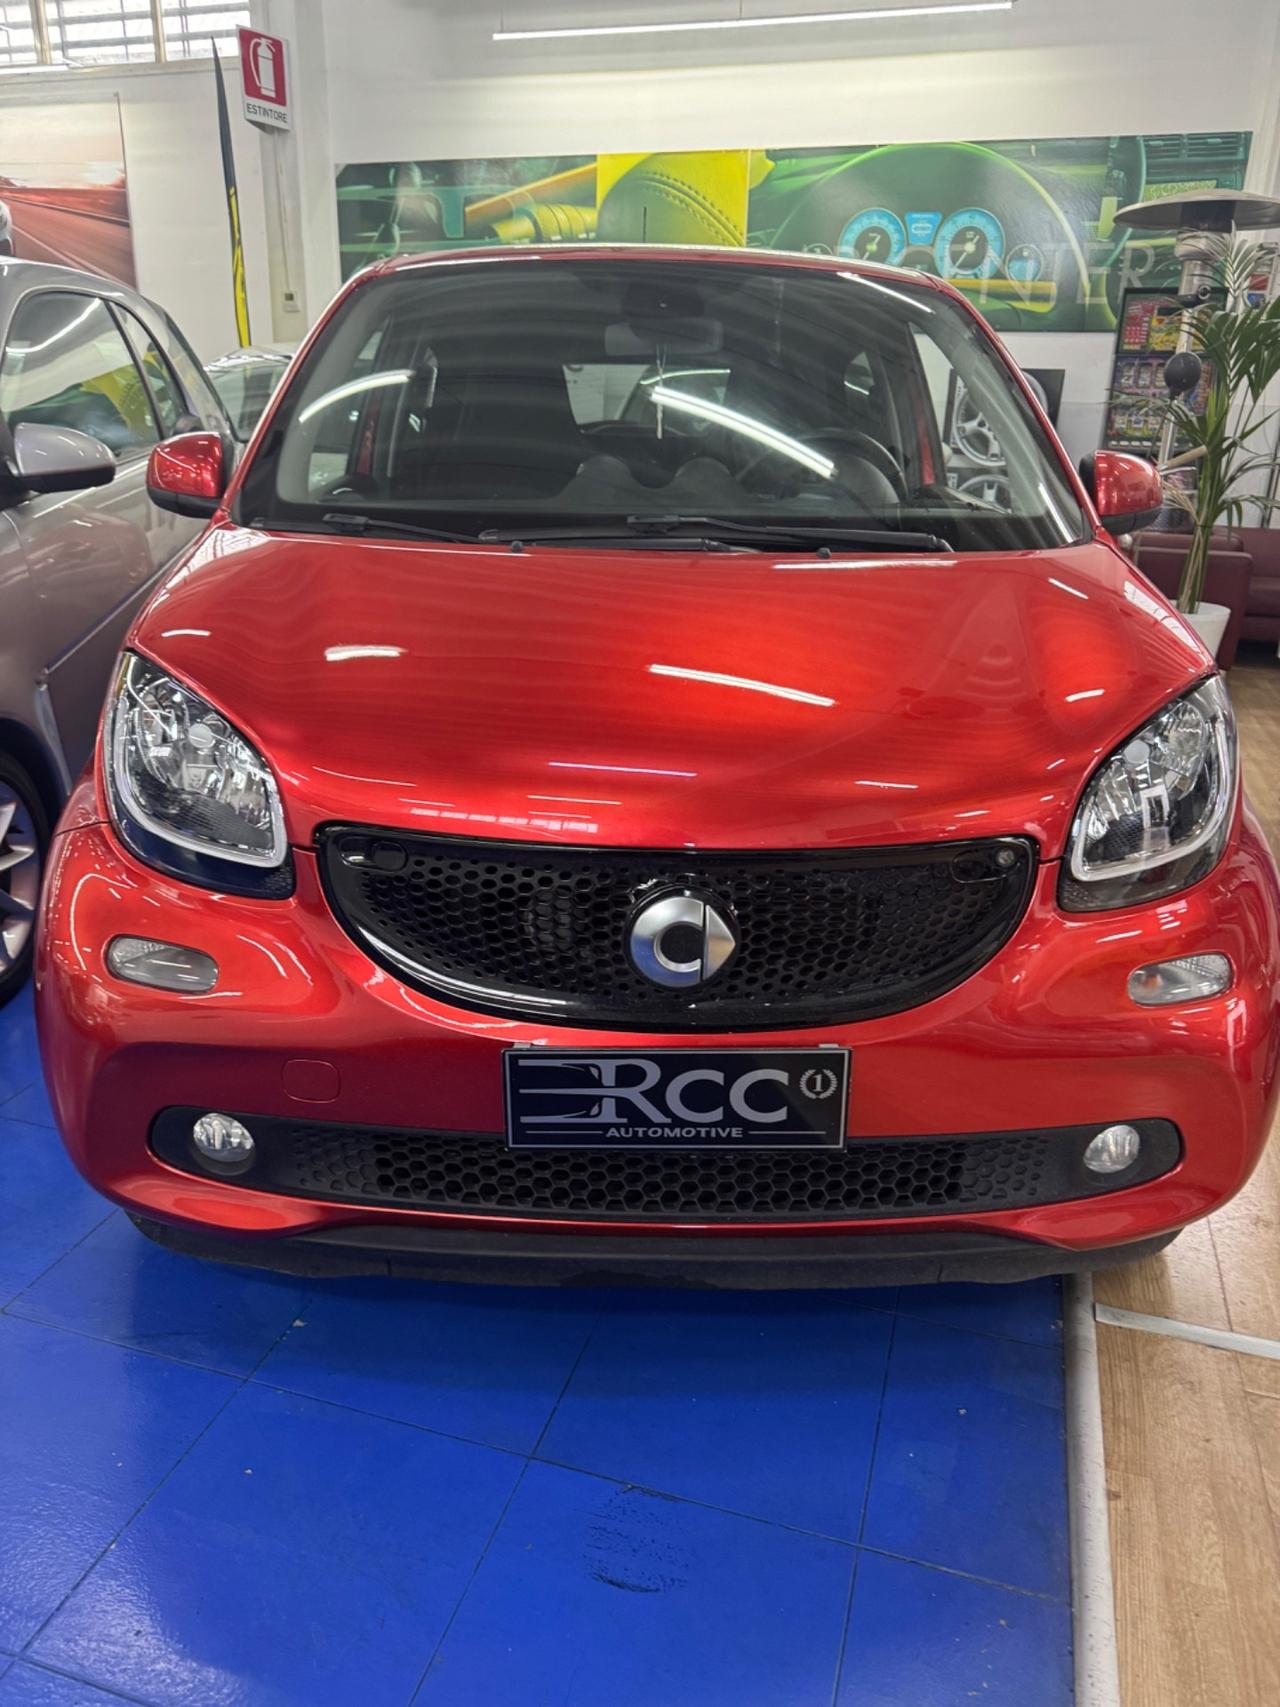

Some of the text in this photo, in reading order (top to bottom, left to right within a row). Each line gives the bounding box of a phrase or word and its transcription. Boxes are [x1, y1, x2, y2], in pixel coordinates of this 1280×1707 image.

[246, 103, 288, 123] ESTINTORE
[812, 1073, 824, 1092] 1
[605, 1126, 744, 1139] AUTOMOTIVE
